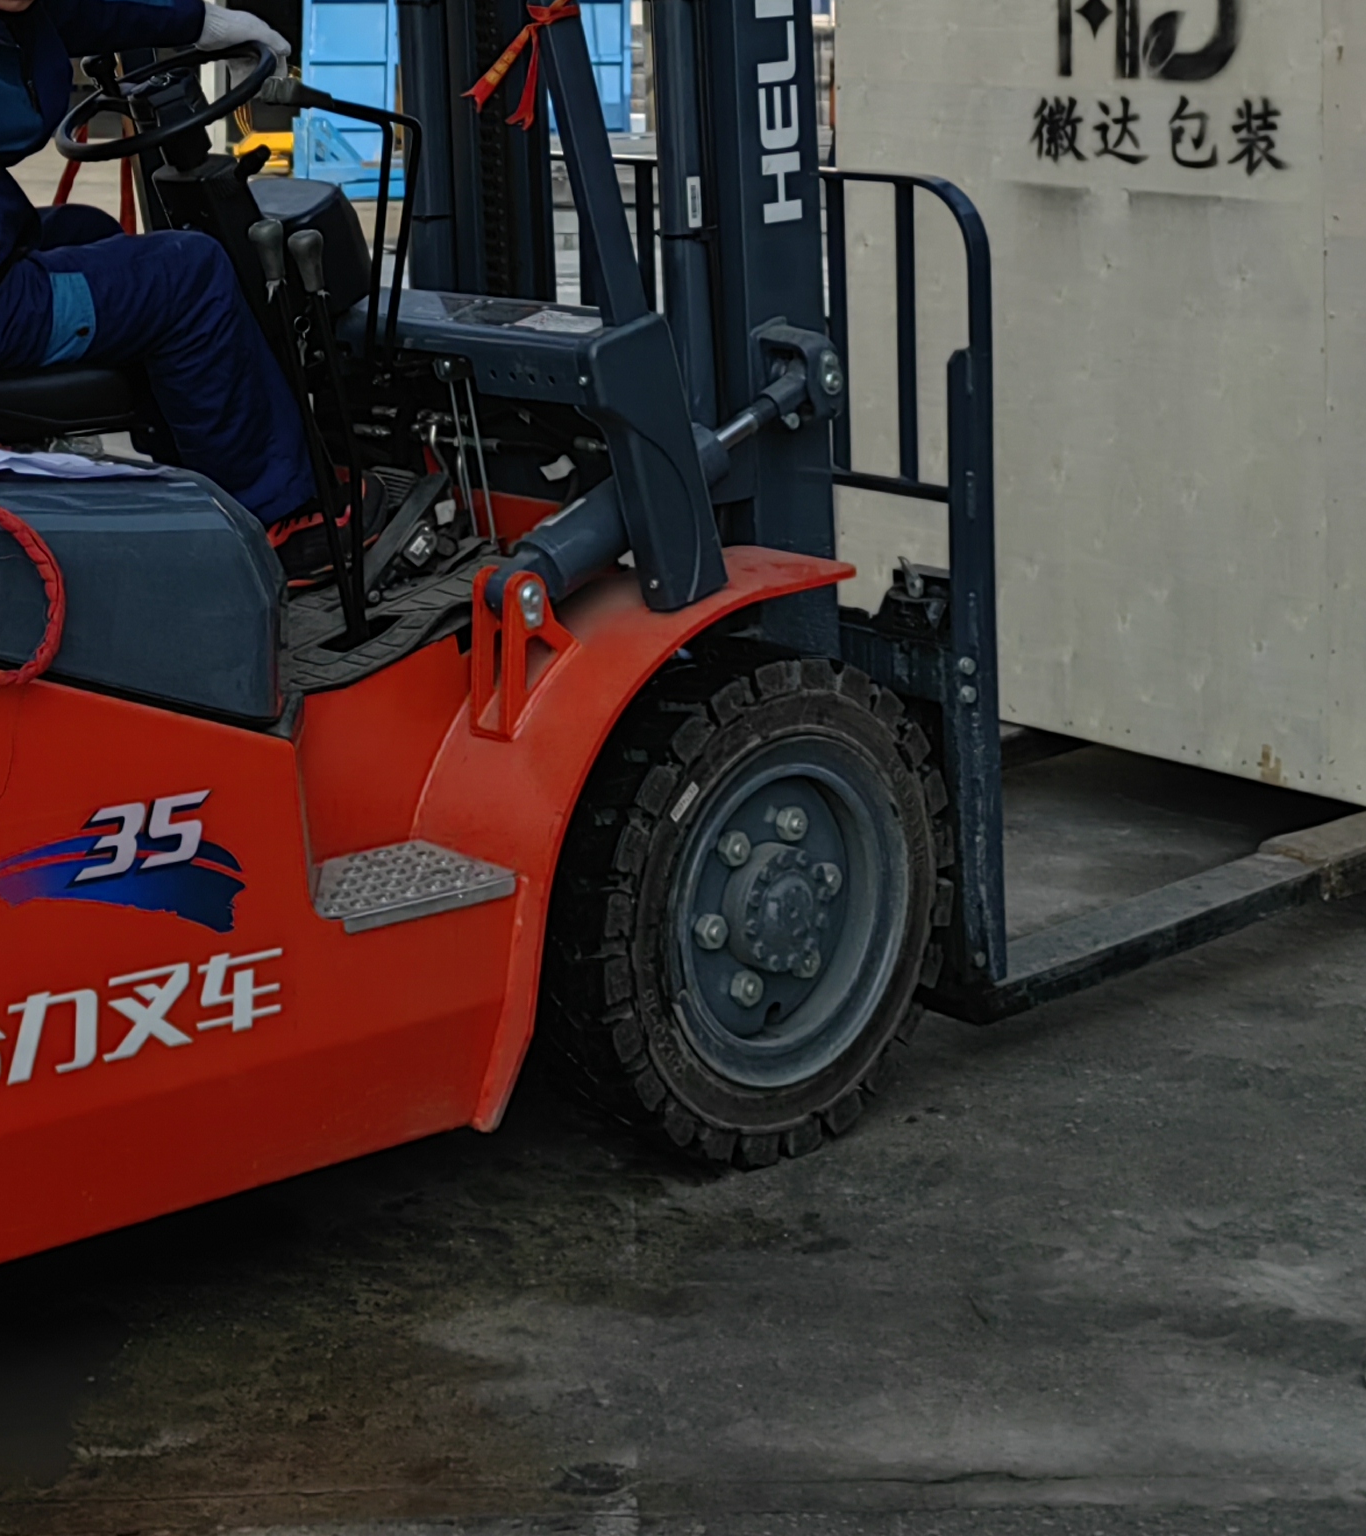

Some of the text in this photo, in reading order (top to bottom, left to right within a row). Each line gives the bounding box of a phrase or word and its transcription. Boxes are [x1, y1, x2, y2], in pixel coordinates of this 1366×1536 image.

[1030, 96, 1290, 176] 徽达包装
[71, 789, 212, 885] 35
